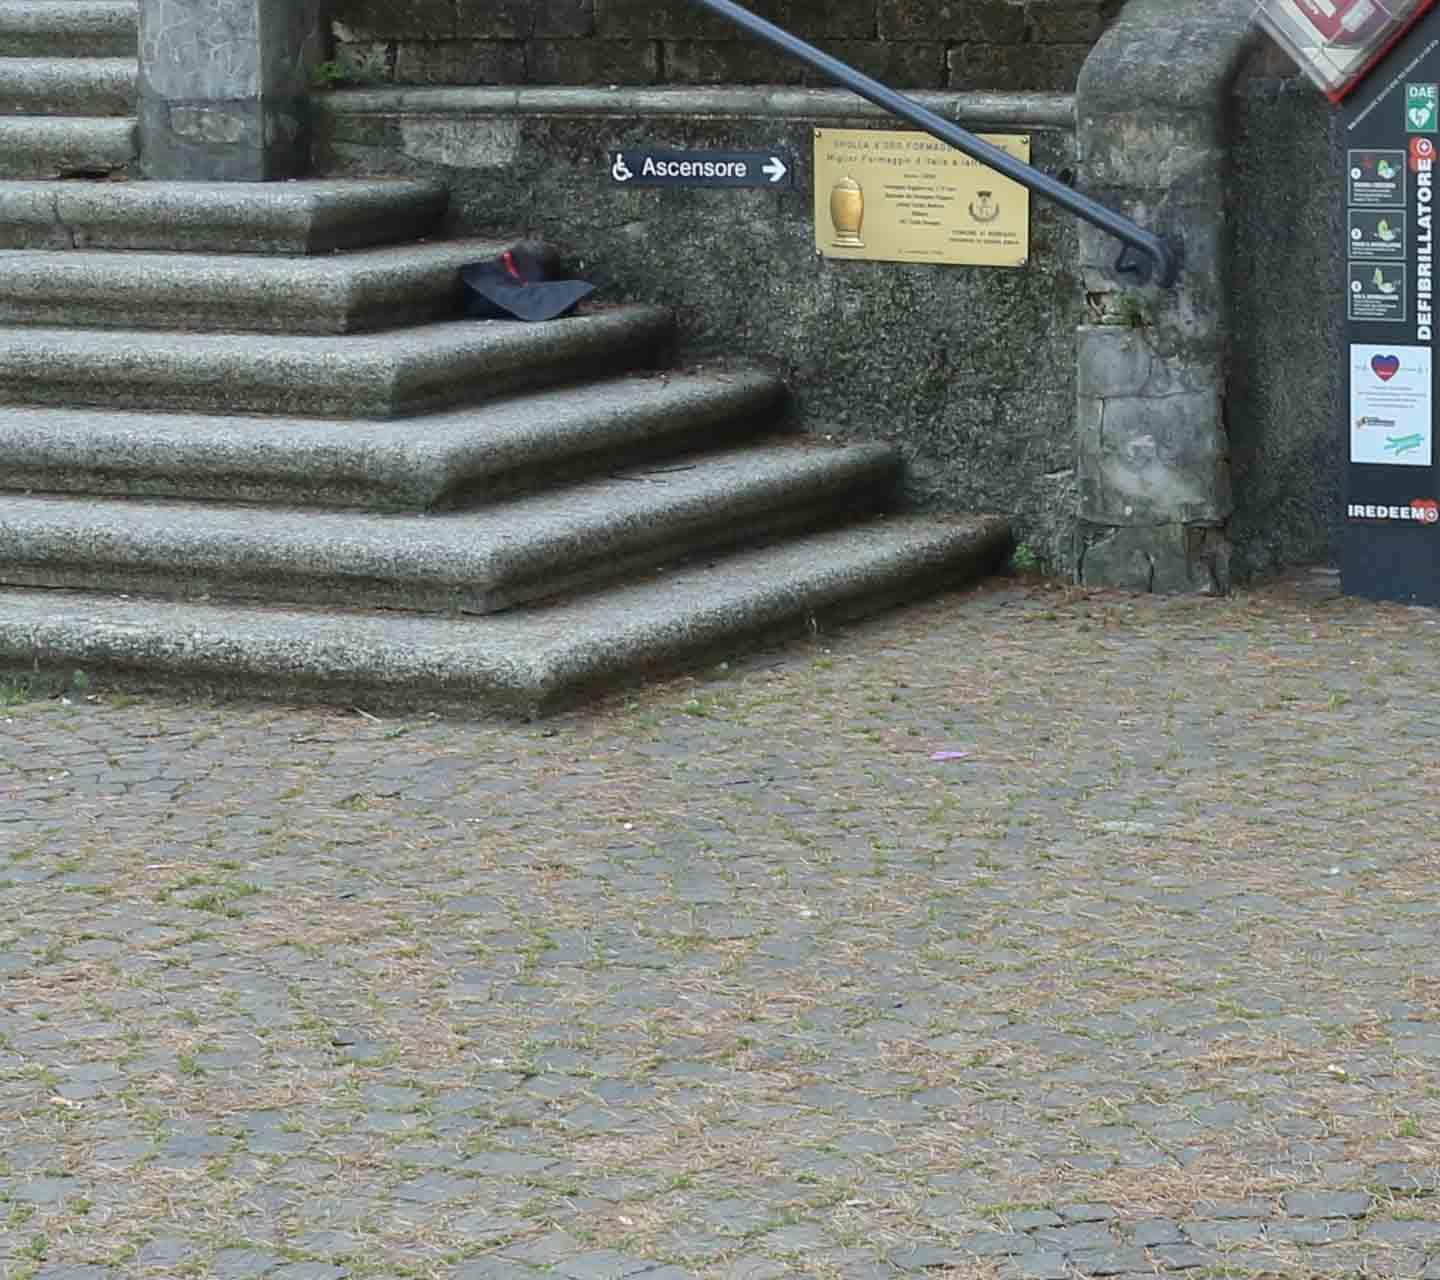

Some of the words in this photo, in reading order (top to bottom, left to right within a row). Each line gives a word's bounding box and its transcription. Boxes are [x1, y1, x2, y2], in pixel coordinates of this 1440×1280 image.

[1408, 86, 1438, 98] DAE
[642, 157, 747, 177] Ascensore
[1417, 158, 1433, 341] DEFIBRILLATORE
